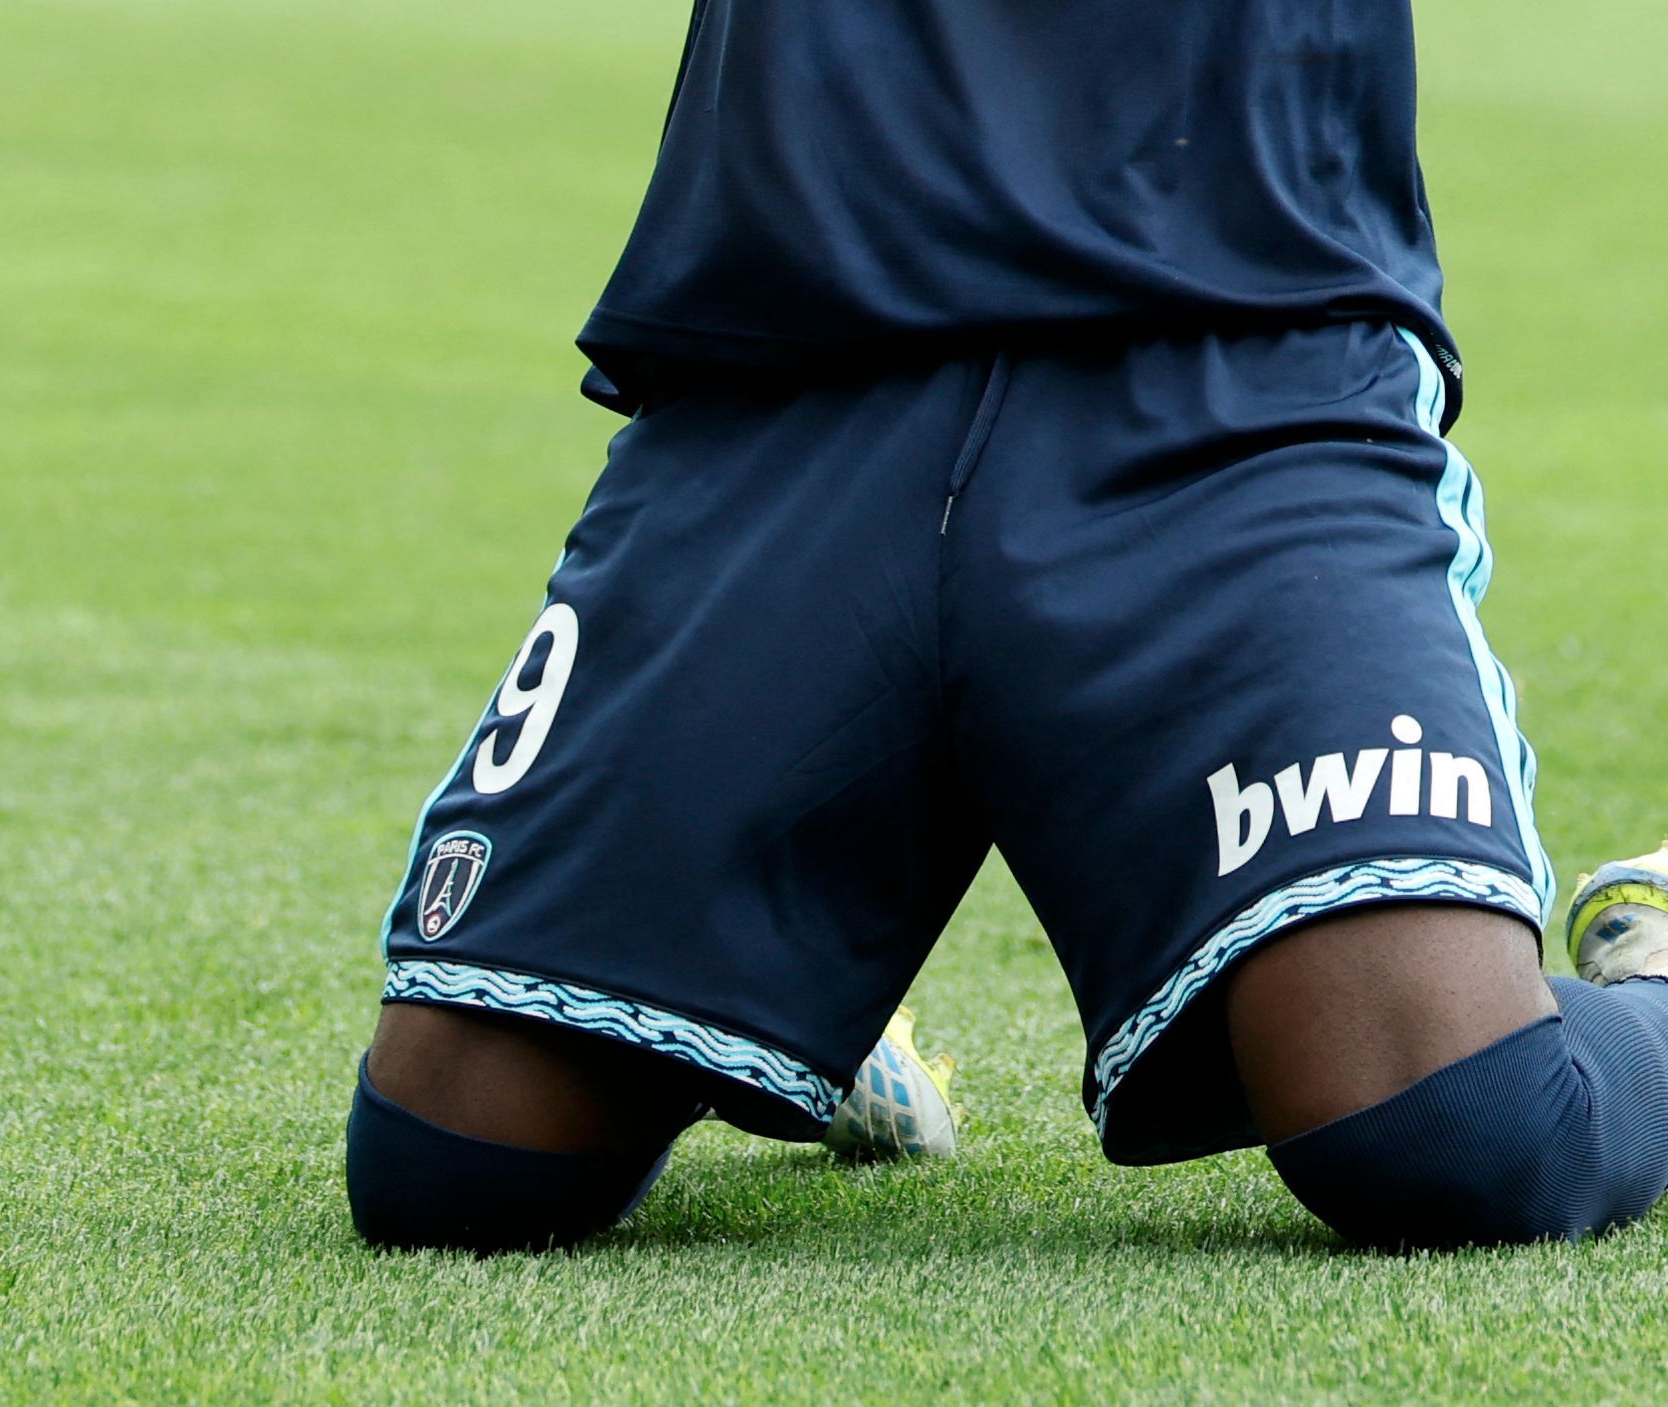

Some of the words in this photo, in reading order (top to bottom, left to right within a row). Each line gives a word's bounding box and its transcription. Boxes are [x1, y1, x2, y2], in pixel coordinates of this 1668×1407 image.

[472, 602, 580, 795] 9
[437, 839, 469, 857] PARIS
[468, 842, 485, 858] FC
[1206, 714, 1492, 878] bwin
